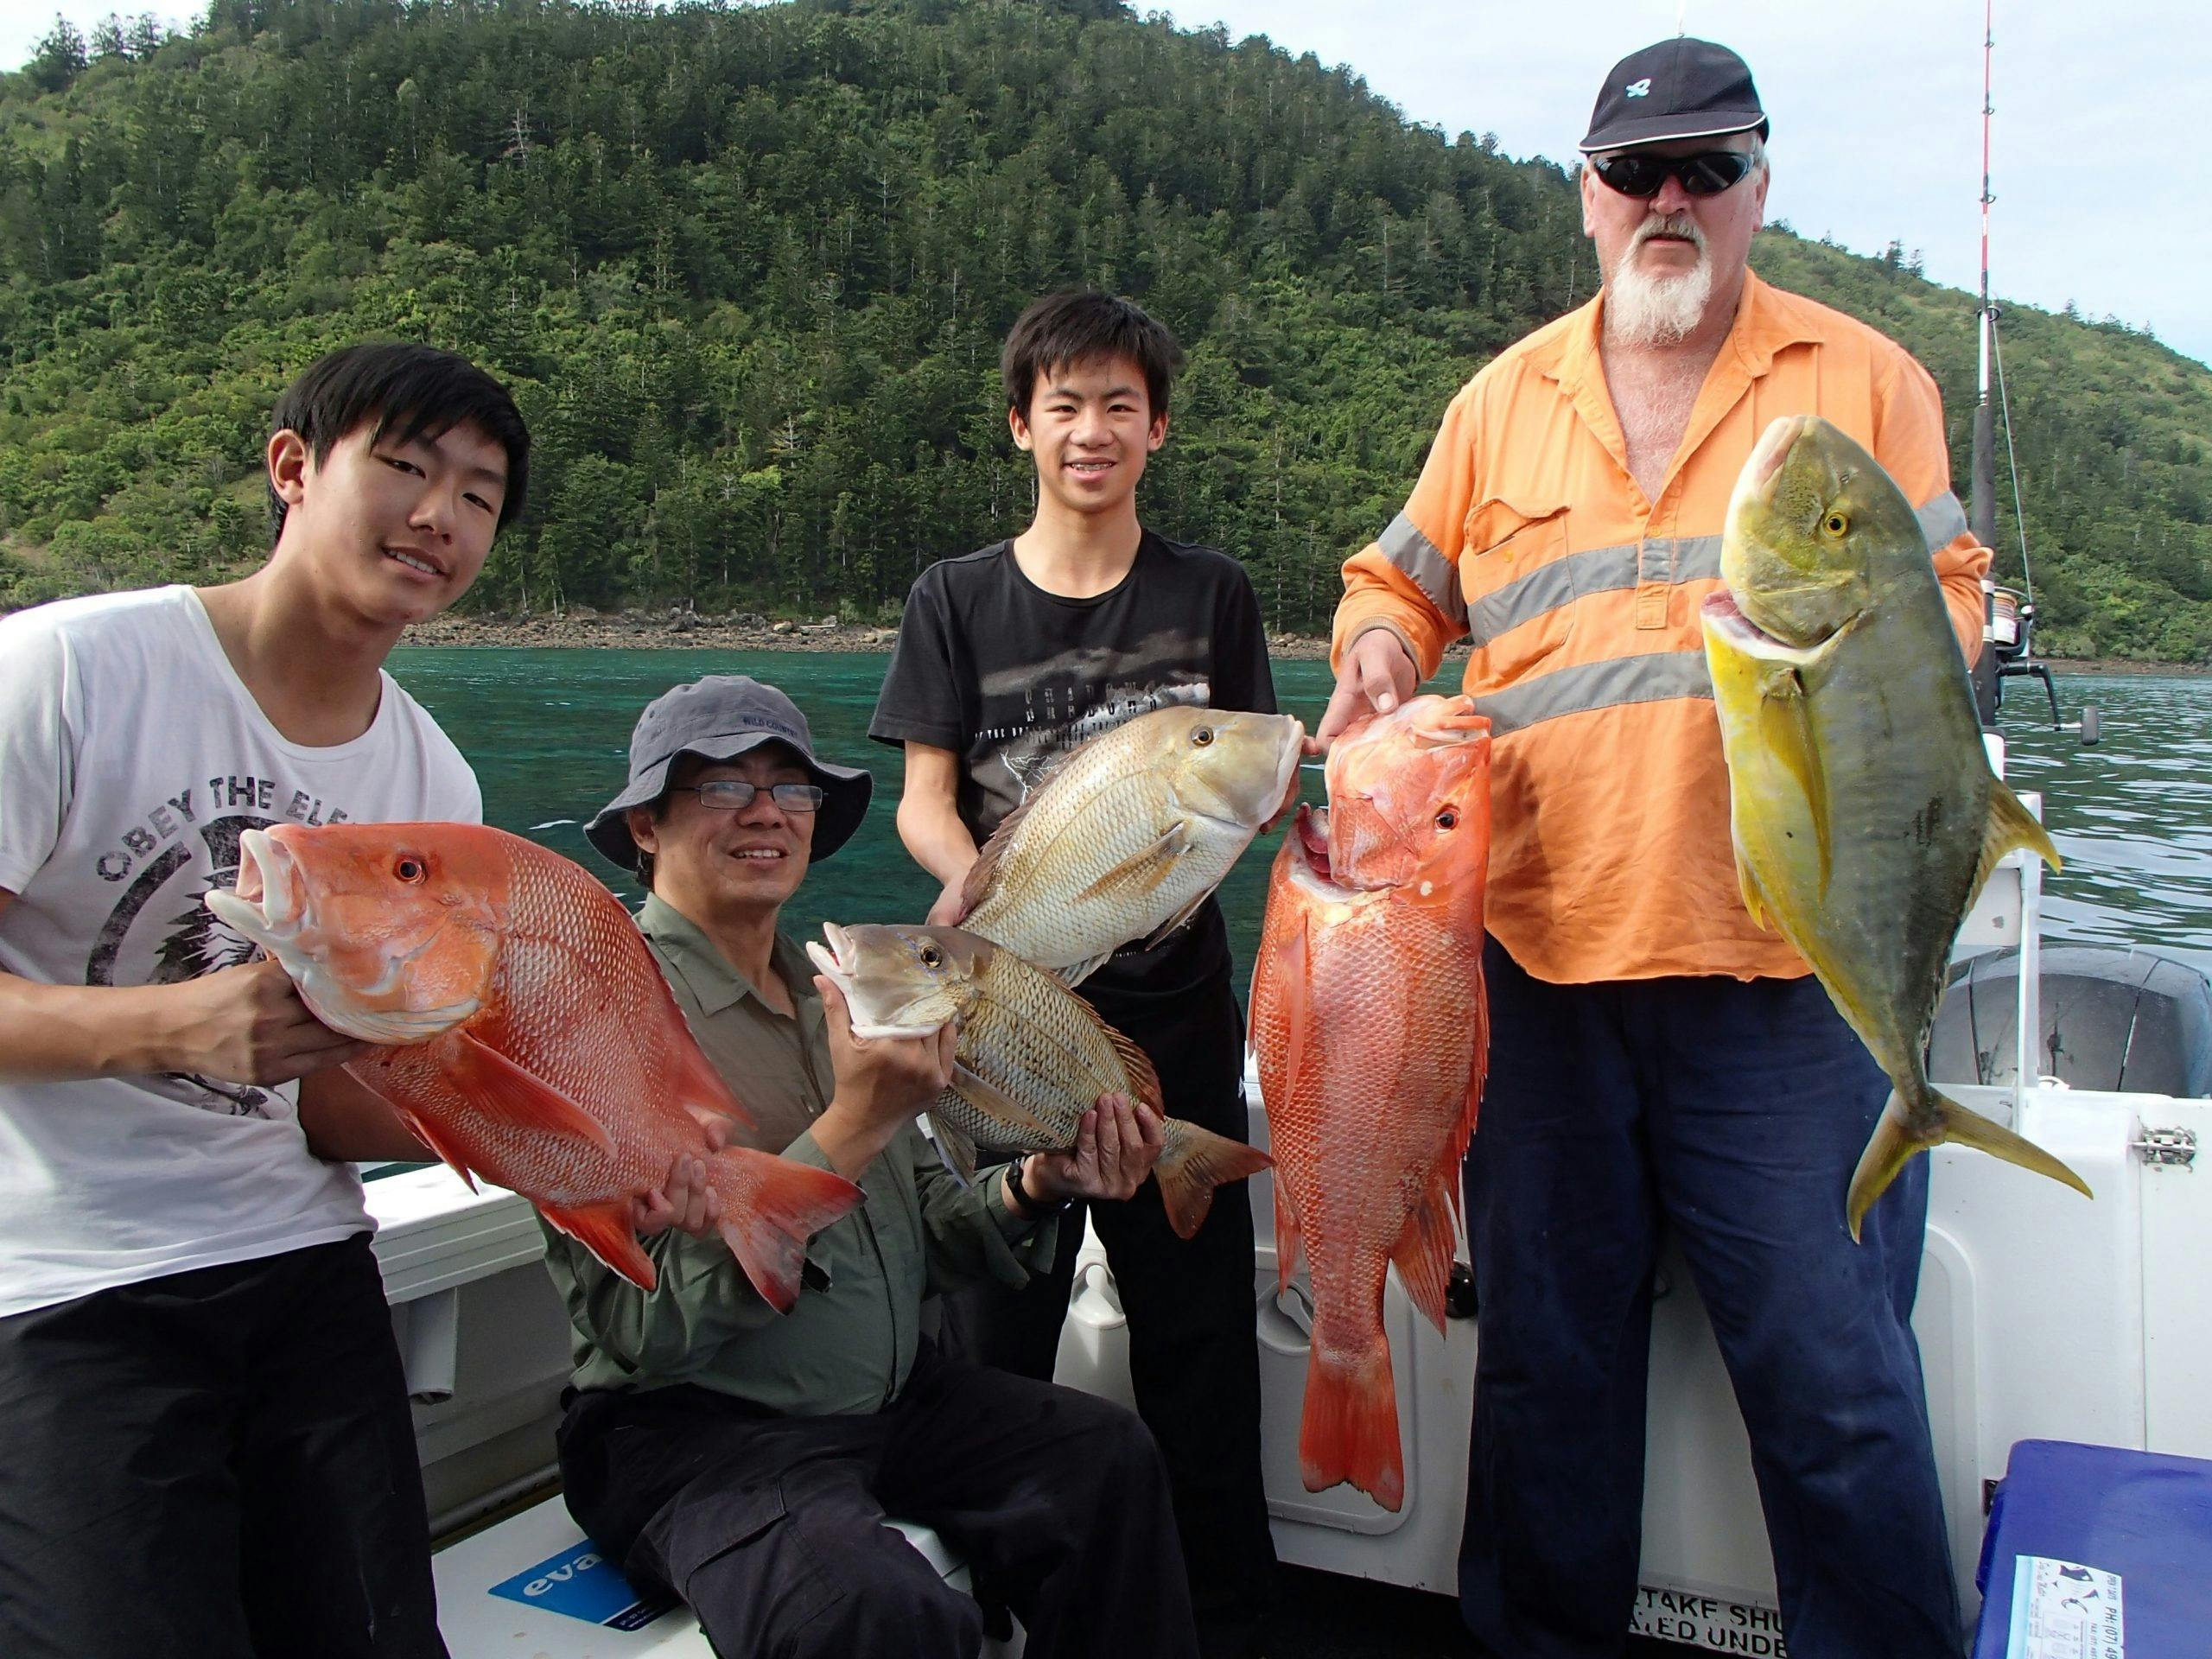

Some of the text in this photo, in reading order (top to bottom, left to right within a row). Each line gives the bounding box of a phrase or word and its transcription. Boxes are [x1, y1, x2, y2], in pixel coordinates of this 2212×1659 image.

[742, 716, 765, 727] WILD
[96, 788, 197, 882] OBEY
[209, 775, 276, 810] THE
[1635, 1587, 1719, 1619] TAKE
[2105, 1606, 2117, 1623] PH:
[2101, 1624, 2117, 1644] (07)
